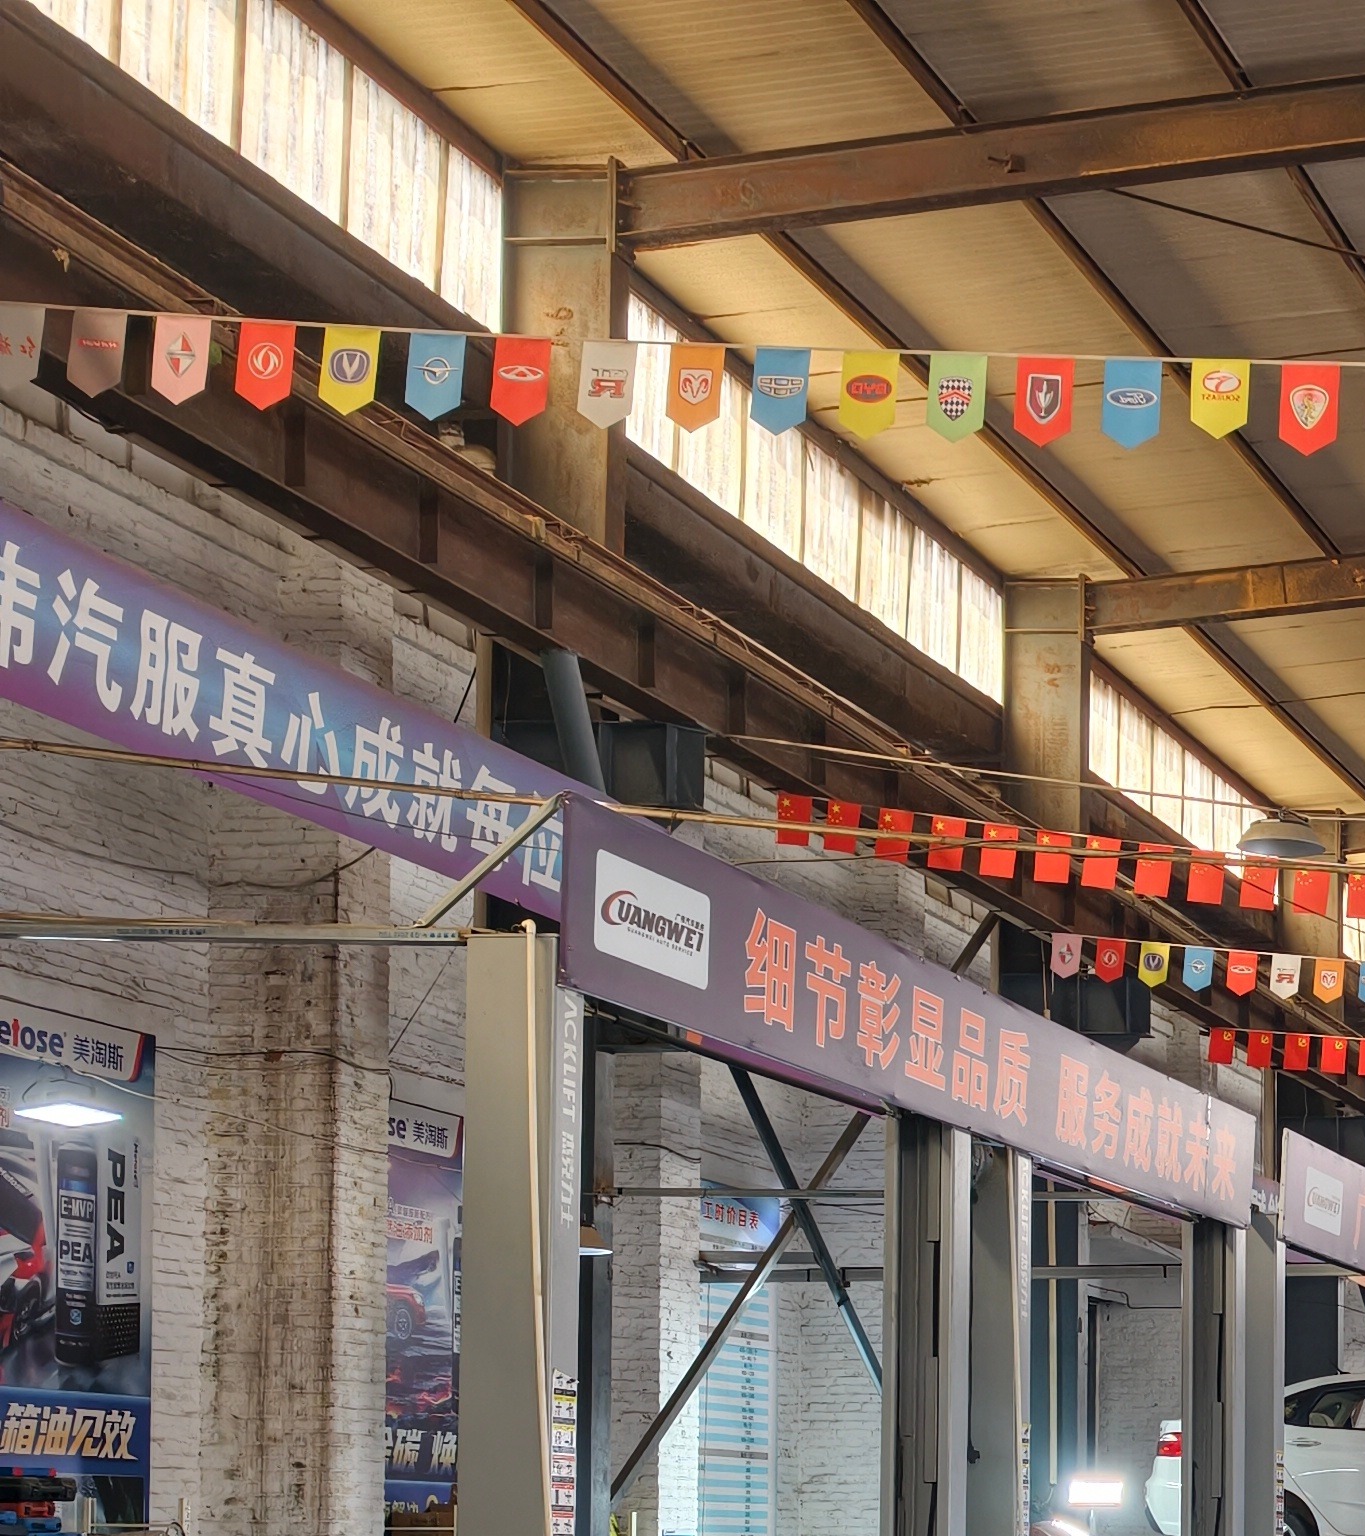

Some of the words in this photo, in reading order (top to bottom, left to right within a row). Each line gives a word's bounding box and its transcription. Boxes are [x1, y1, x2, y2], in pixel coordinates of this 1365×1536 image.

[72, 1034, 124, 1072] 美淘斯
[743, 906, 1033, 1127] 细节彰显品质
[1055, 1053, 1237, 1201] 服务成就未来
[61, 1196, 94, 1220] E-MVP
[106, 1147, 126, 1264] PEA
[703, 1201, 760, 1231] 工时价目表
[59, 1240, 93, 1264] PEA
